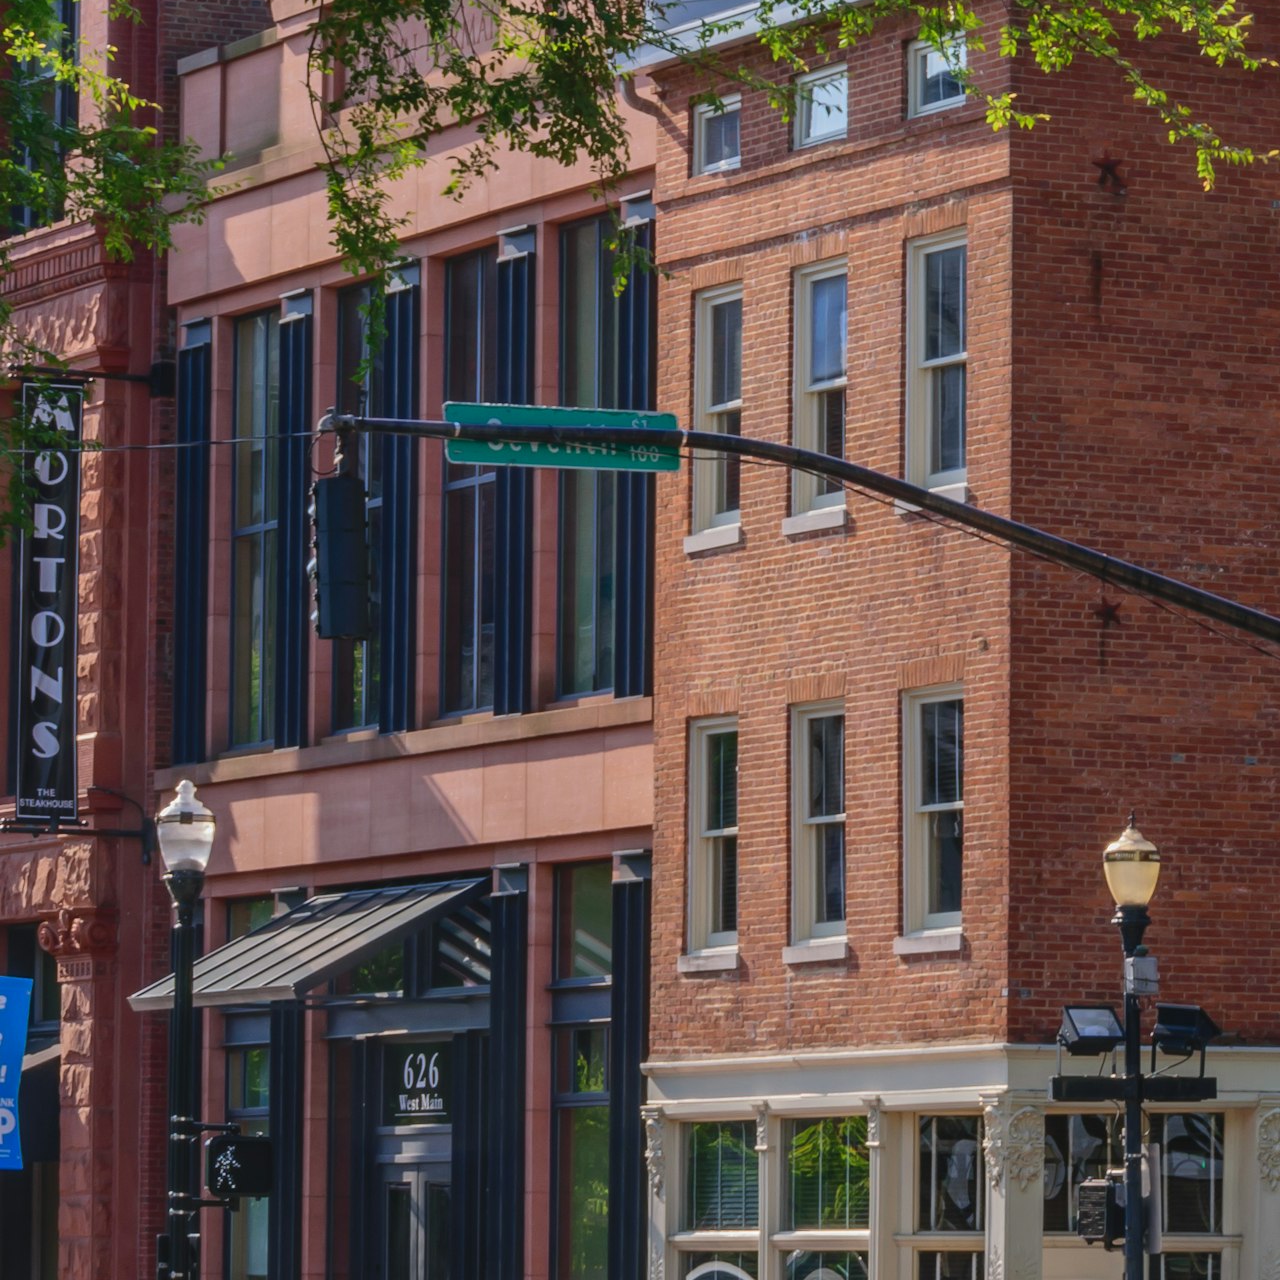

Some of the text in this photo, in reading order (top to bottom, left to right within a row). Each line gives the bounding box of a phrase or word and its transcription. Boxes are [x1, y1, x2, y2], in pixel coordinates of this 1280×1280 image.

[631, 445, 660, 462] 100
[28, 392, 76, 759] MORTONS
[37, 788, 56, 797] THE
[19, 798, 74, 809] STEAKHOUSE
[403, 1052, 439, 1089] 626
[398, 1093, 444, 1111] West Main
